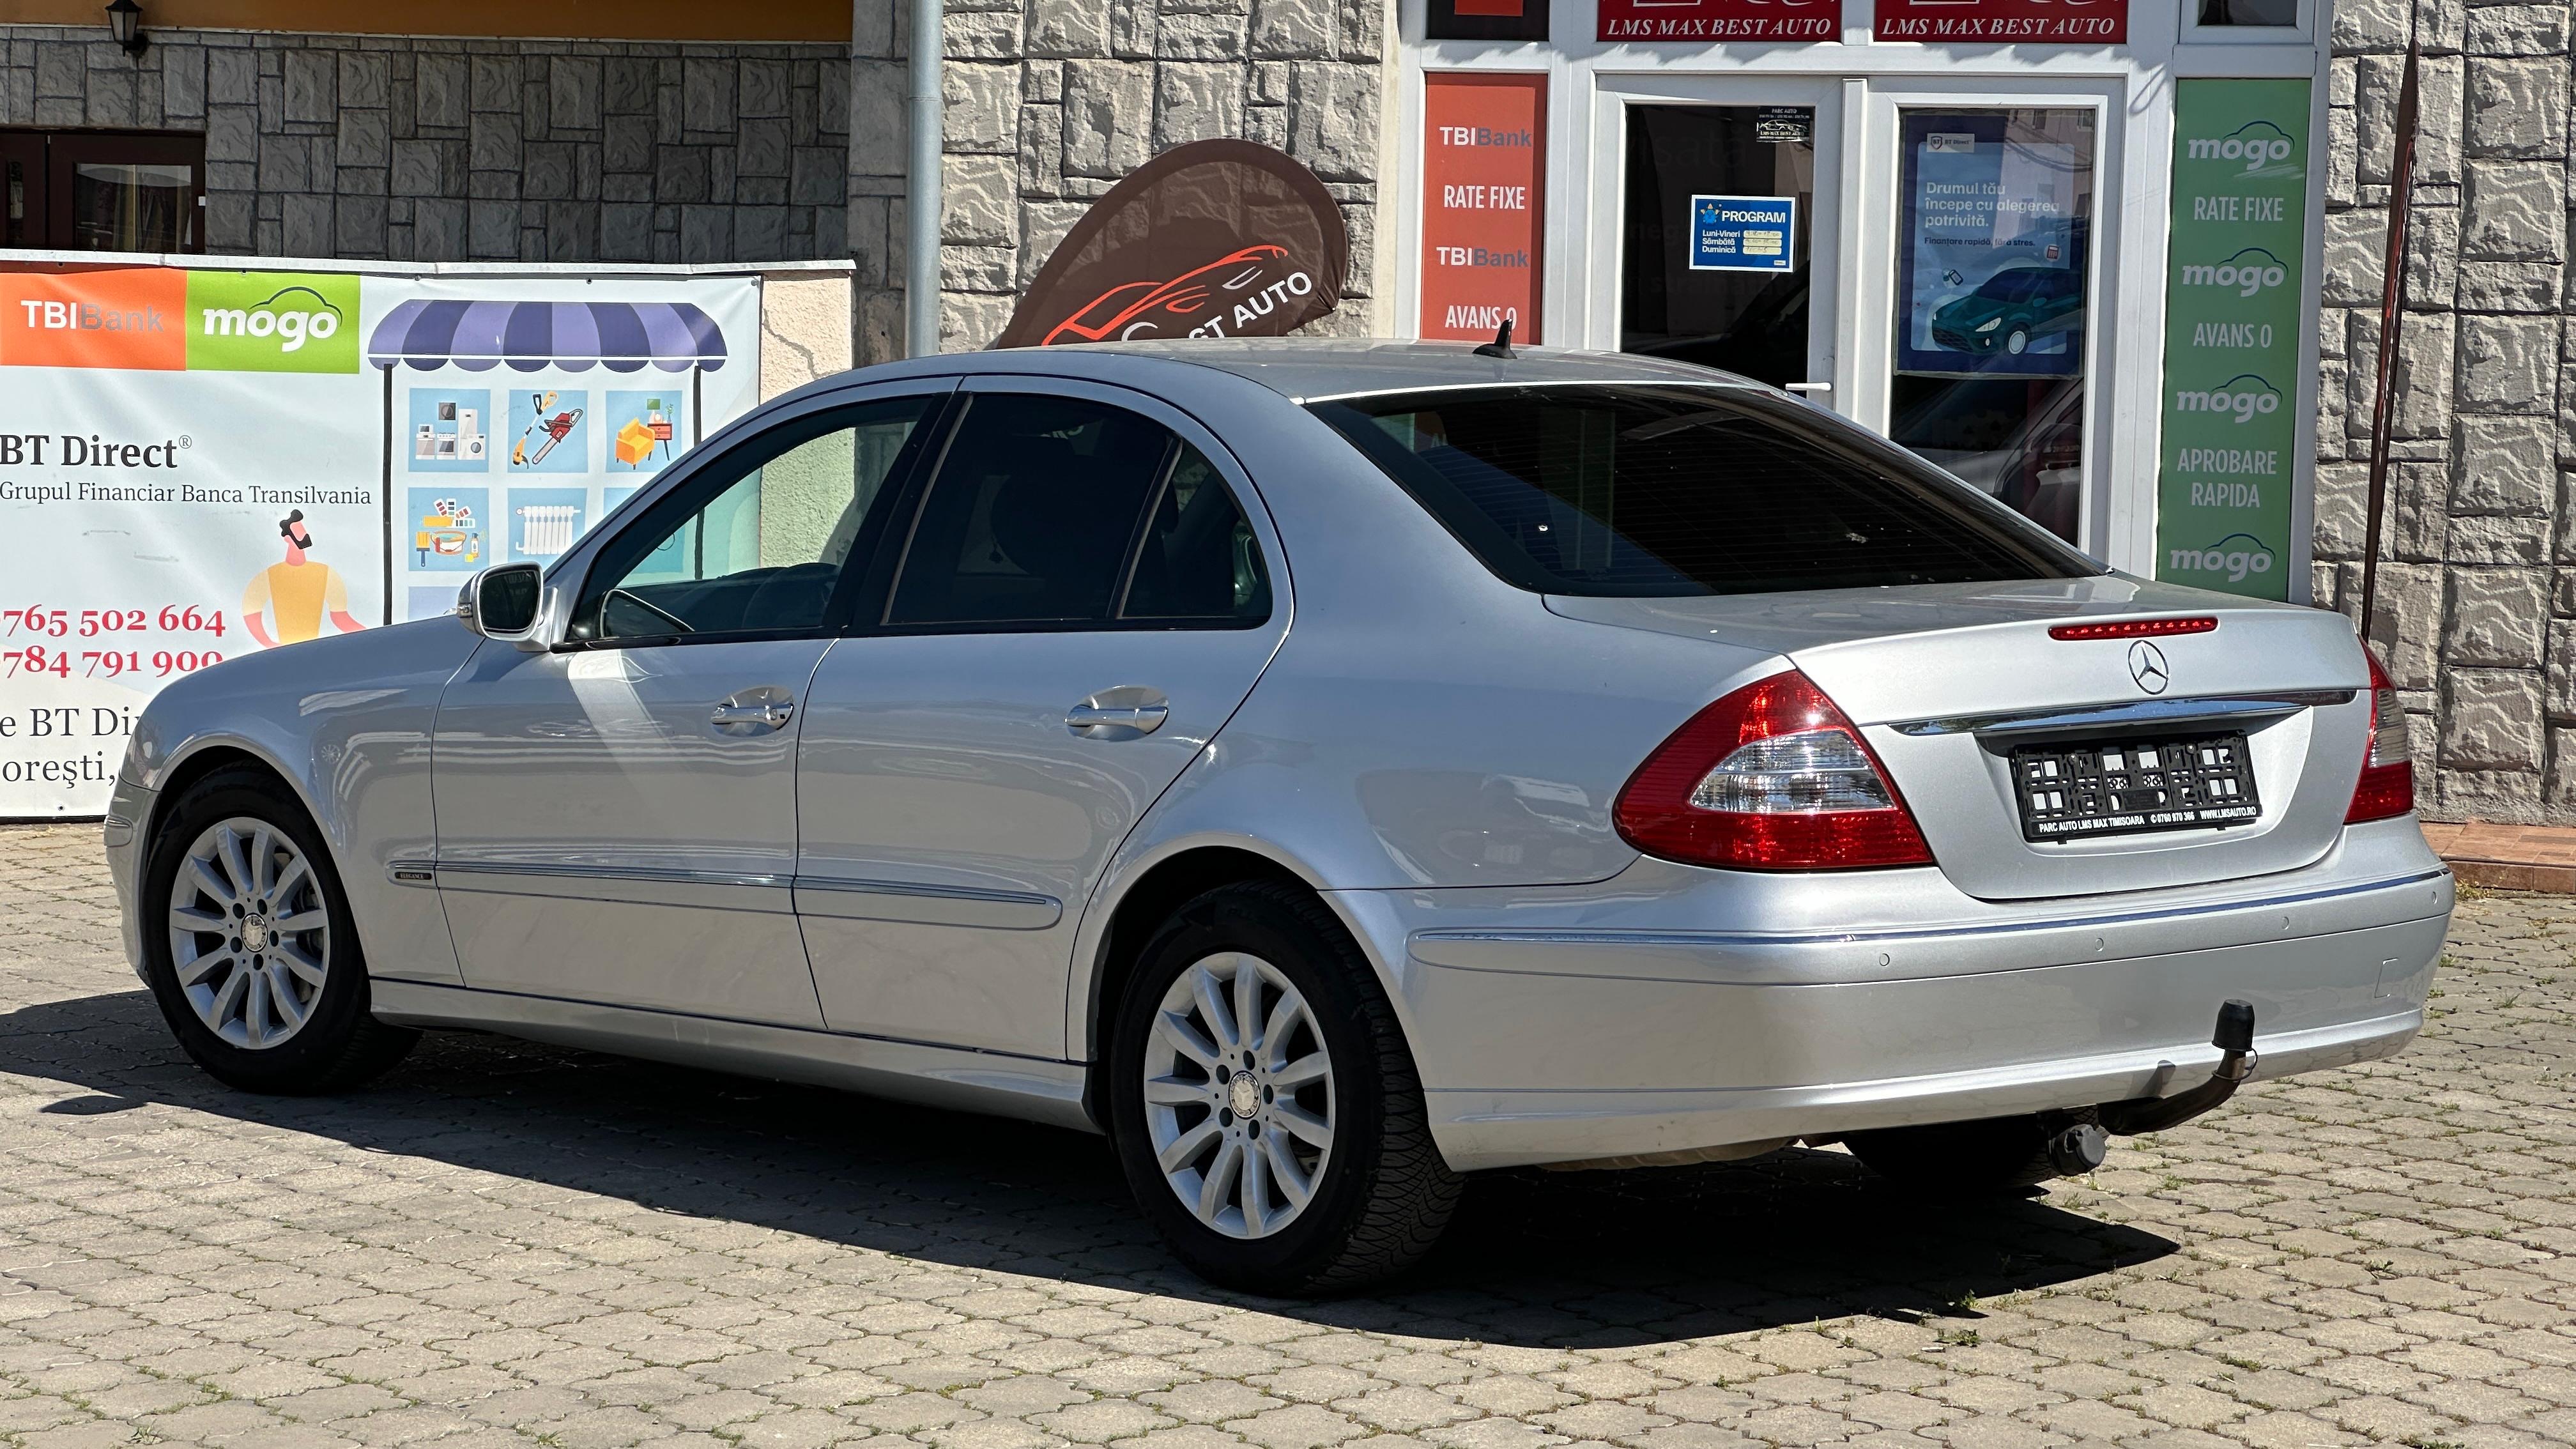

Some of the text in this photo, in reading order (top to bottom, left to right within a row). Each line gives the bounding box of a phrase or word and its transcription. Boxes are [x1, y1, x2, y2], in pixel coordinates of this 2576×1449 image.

[1607, 18, 1831, 35] LMS MAX BEST AUTO
[1882, 18, 2115, 34] LMS MAX BEST AUTO
[1439, 126, 1531, 147] TBIBank
[2188, 139, 2290, 171] mogo
[1444, 185, 1525, 210] RATE FIXE
[1926, 182, 2006, 194] Drumul tău
[1721, 211, 1786, 224] PROGRAM
[1924, 198, 2060, 213] începe cu alegerea
[2194, 196, 2283, 221] RATE FIXE
[1924, 215, 1989, 228] potrivită.
[2013, 238, 2035, 247] stres.
[1436, 247, 1528, 268] TBIBank
[2182, 265, 2284, 297] mogo
[1234, 272, 1312, 328] AUTO
[20, 300, 164, 332] TBIBank
[1445, 305, 1500, 329] AVANS
[202, 308, 337, 352] mogo
[2193, 323, 2254, 348] AVANS
[2177, 391, 2278, 424] mogo
[0, 435, 49, 465] BT
[2177, 448, 2277, 475] APROBARE
[0, 481, 371, 506] Grupul Financiar Banca Transilvania
[2191, 482, 2260, 508] RAPIDA
[2170, 549, 2272, 583] mogo
[0, 604, 226, 637] 765 502 664
[0, 645, 71, 678] 784
[82, 651, 142, 678] 791
[29, 708, 80, 736] BT
[91, 706, 141, 736] Di
[2039, 823, 2058, 832] PARC
[2058, 820, 2077, 831] AUTO
[2078, 819, 2092, 829] LMS
[2092, 818, 2108, 828] MAX
